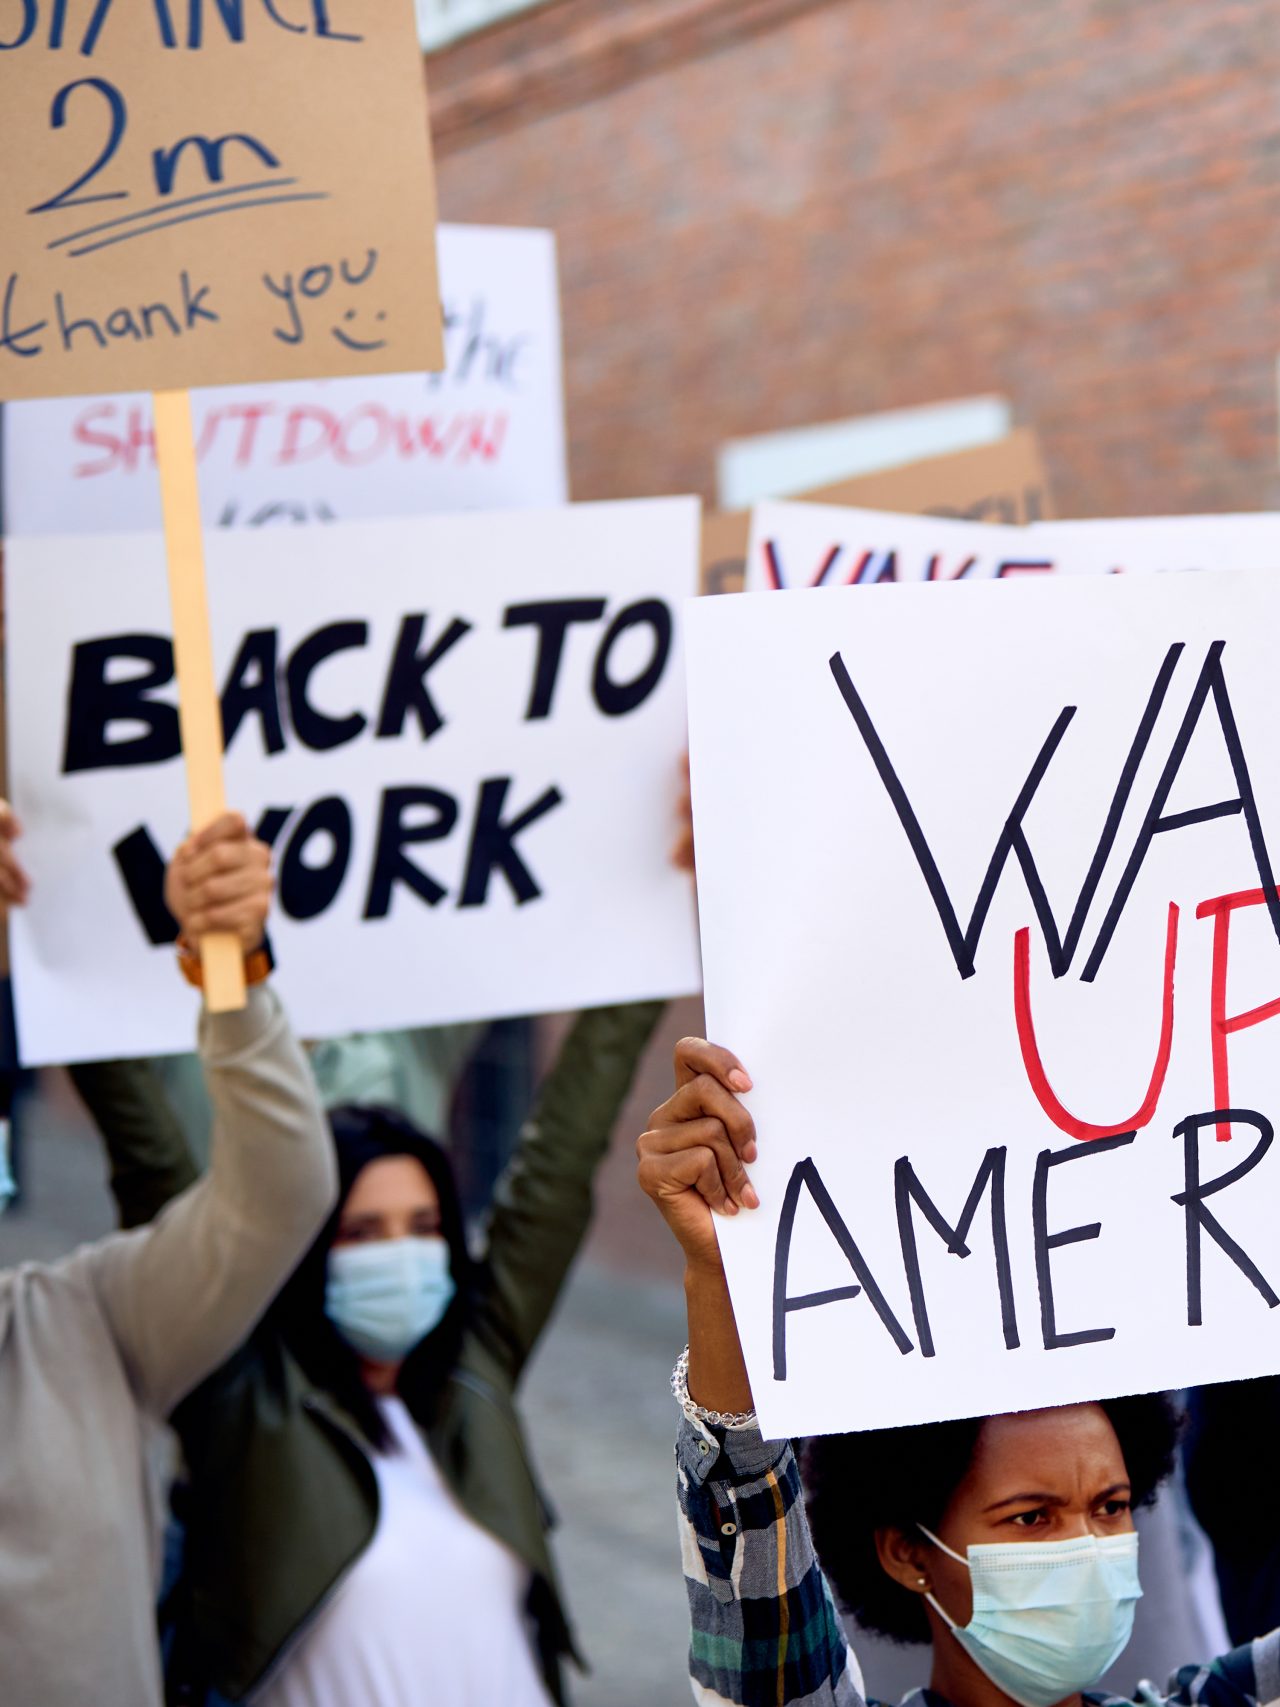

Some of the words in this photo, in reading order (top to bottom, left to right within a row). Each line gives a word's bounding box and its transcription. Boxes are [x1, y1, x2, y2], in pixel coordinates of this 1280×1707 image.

[27, 76, 281, 216] 2m
[0, 270, 219, 357] thank
[262, 248, 377, 345] you
[428, 290, 530, 392] he
[61, 612, 474, 777] BACK
[500, 594, 674, 722] TO
